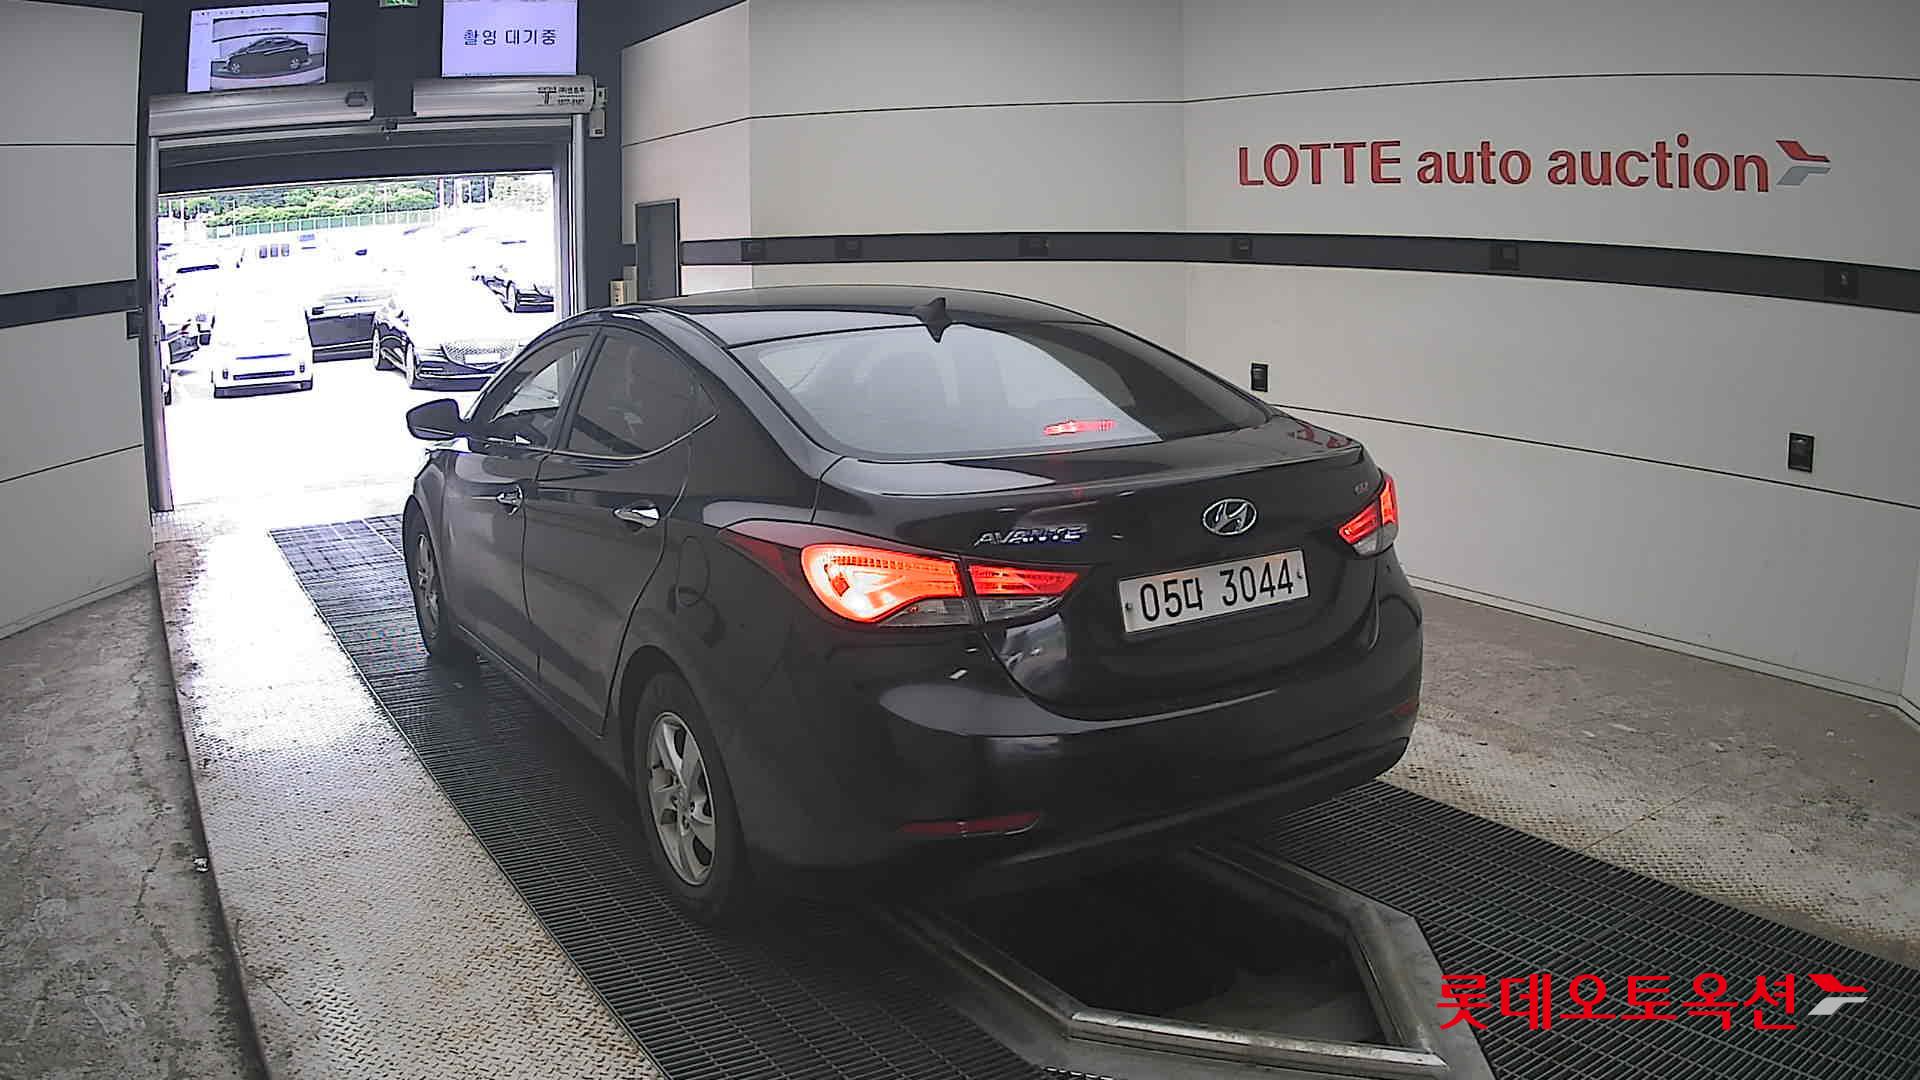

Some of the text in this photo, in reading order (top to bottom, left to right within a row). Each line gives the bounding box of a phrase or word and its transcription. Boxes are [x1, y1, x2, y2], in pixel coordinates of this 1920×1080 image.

[464, 29, 557, 46] 촬영 대기중
[1238, 133, 1769, 192] LOTTE auto auction
[974, 526, 1083, 547] AVANTE
[1139, 558, 1294, 622] 05다 3044
